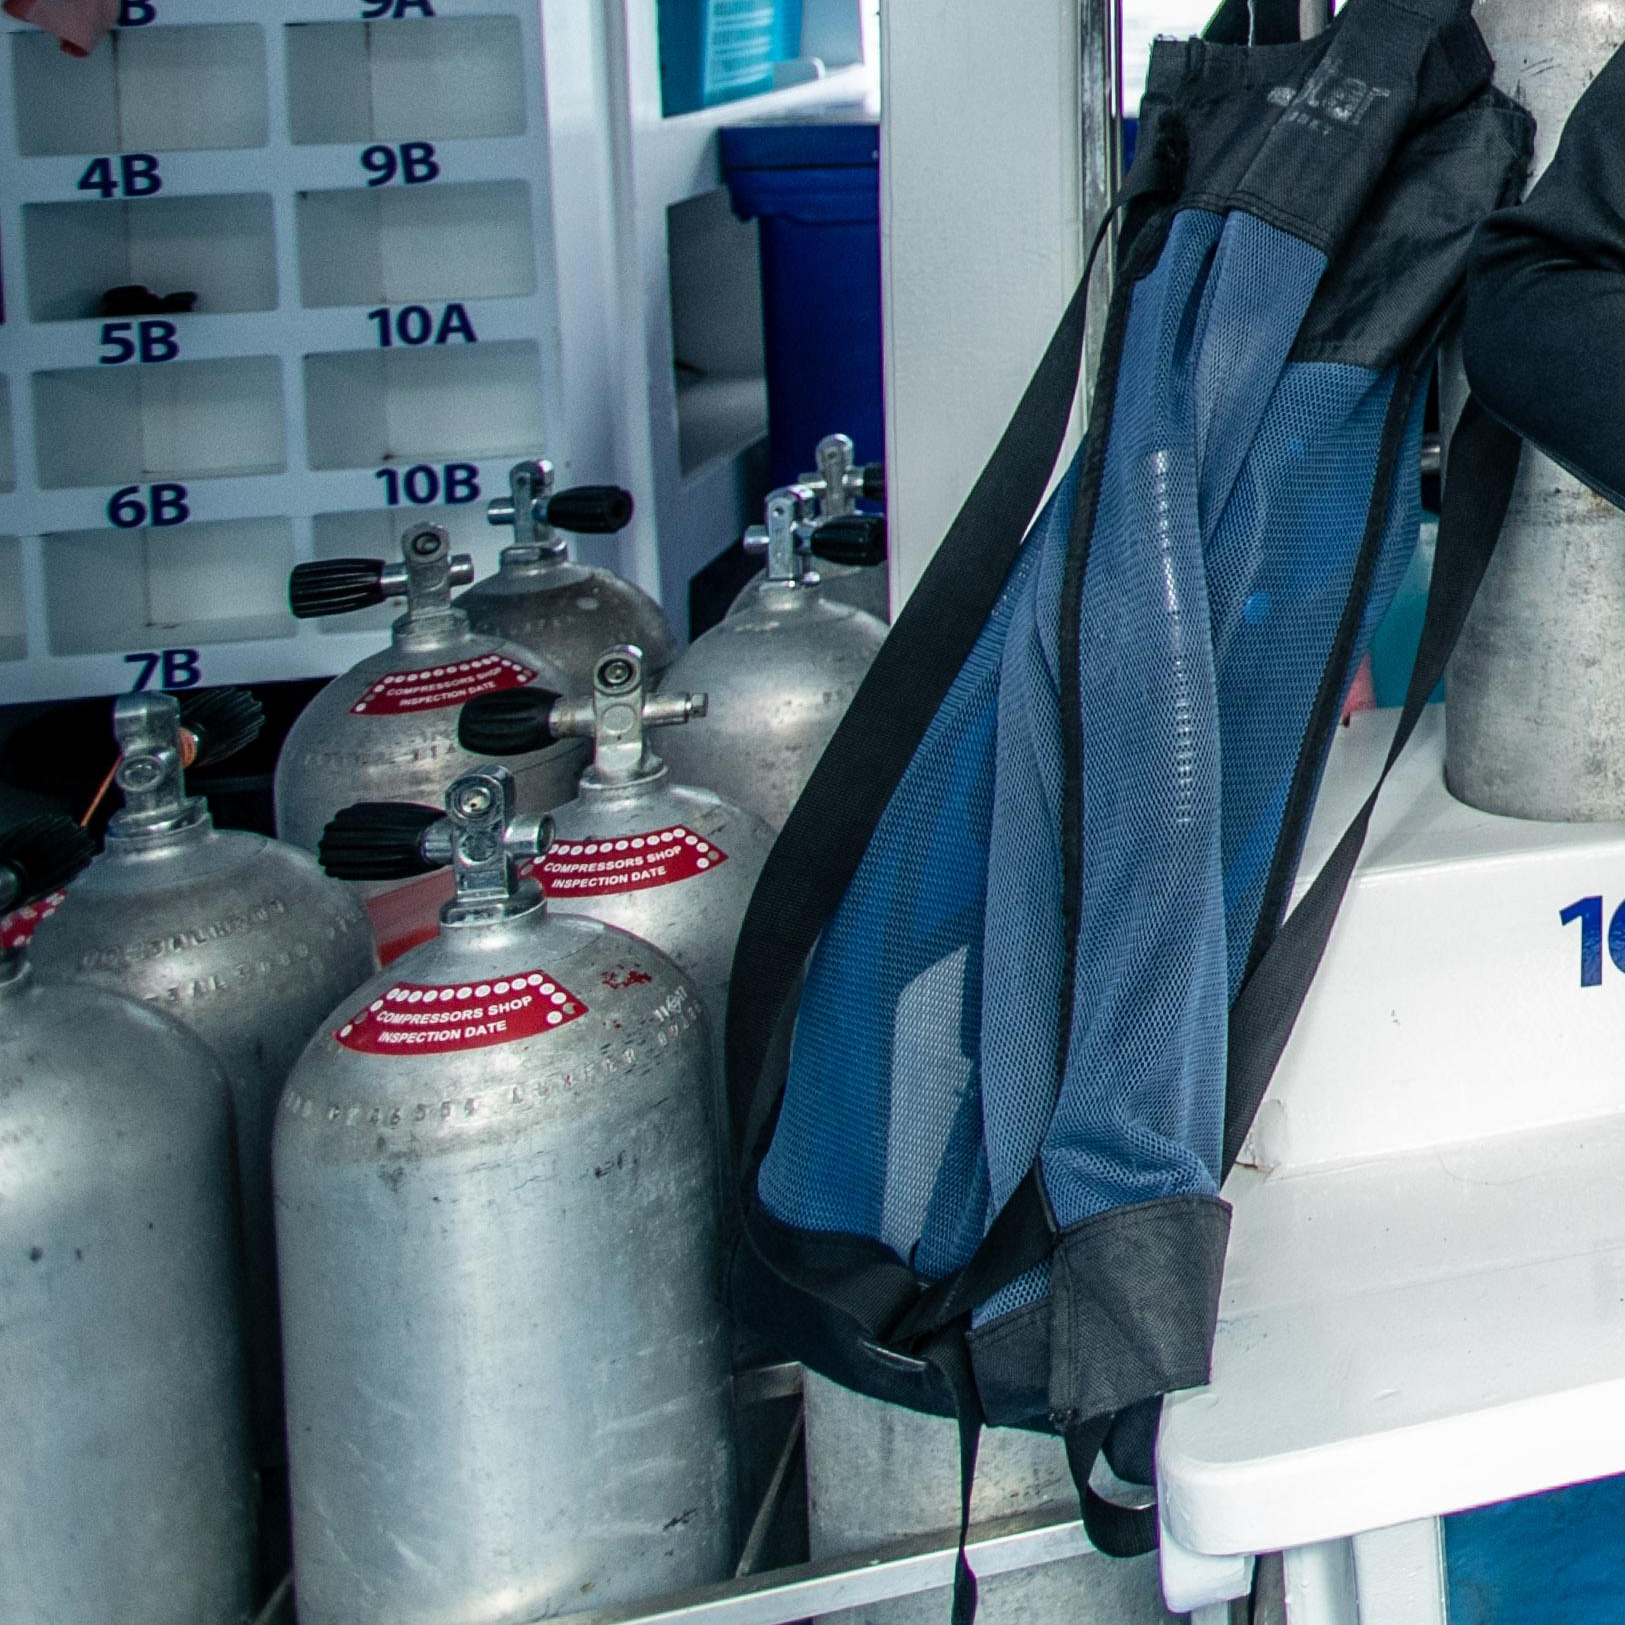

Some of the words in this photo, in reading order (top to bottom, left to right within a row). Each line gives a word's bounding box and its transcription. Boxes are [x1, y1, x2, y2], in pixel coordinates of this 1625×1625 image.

[77, 152, 163, 199] 4B
[360, 141, 441, 188] 9B
[100, 319, 180, 365] 5B
[367, 302, 479, 348] 10A
[106, 482, 191, 529] 6B
[375, 462, 483, 507] 10B
[124, 648, 202, 692] 7B
[386, 675, 476, 697] COMPRESSORS
[399, 688, 467, 707] INSPECTION
[468, 680, 497, 695] DATE
[543, 855, 644, 874] COMPRESSORS
[646, 845, 683, 864] SHOP
[551, 873, 629, 889] INSPECTION
[631, 865, 667, 882] DATE
[376, 1004, 483, 1026] COMPRESSORS
[487, 994, 534, 1016] SHOP
[377, 1027, 462, 1044] INSPECTION
[464, 1019, 508, 1039] DATE
